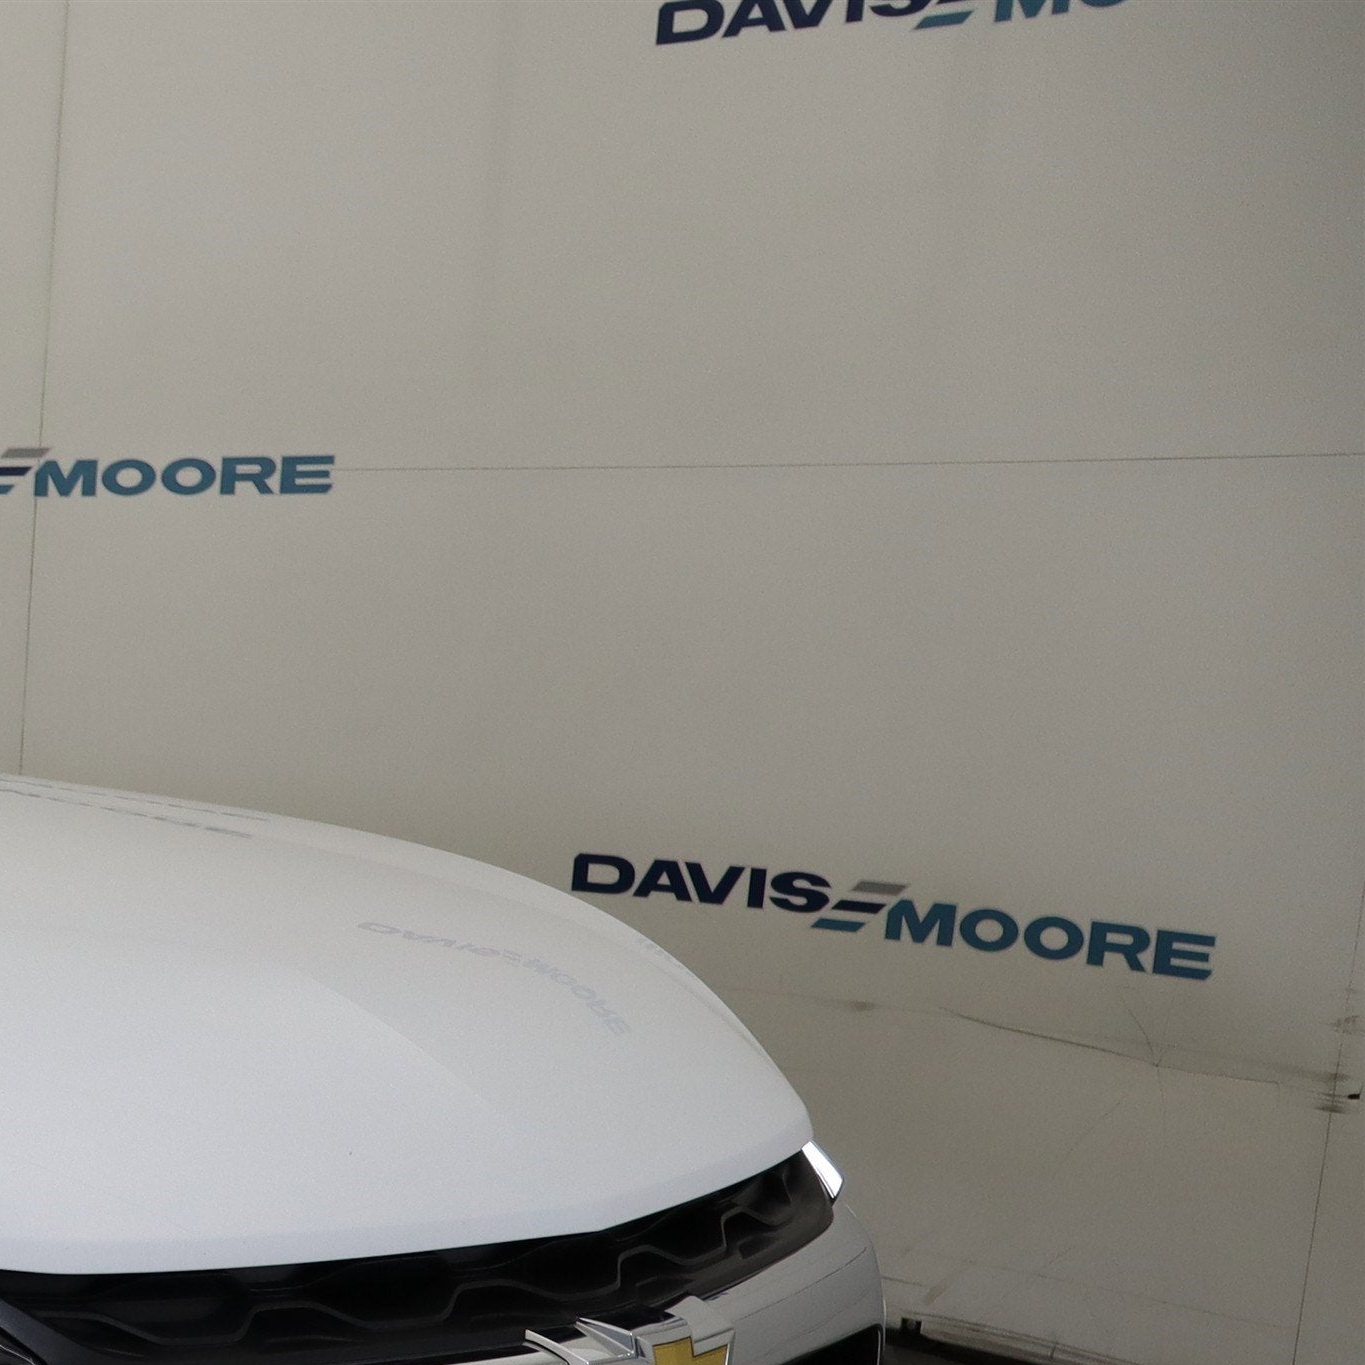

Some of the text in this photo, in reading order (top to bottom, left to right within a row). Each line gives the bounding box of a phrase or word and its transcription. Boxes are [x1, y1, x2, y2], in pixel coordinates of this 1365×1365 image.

[34, 455, 335, 497] MOORE
[571, 853, 1217, 981] DAVIS MOORE
